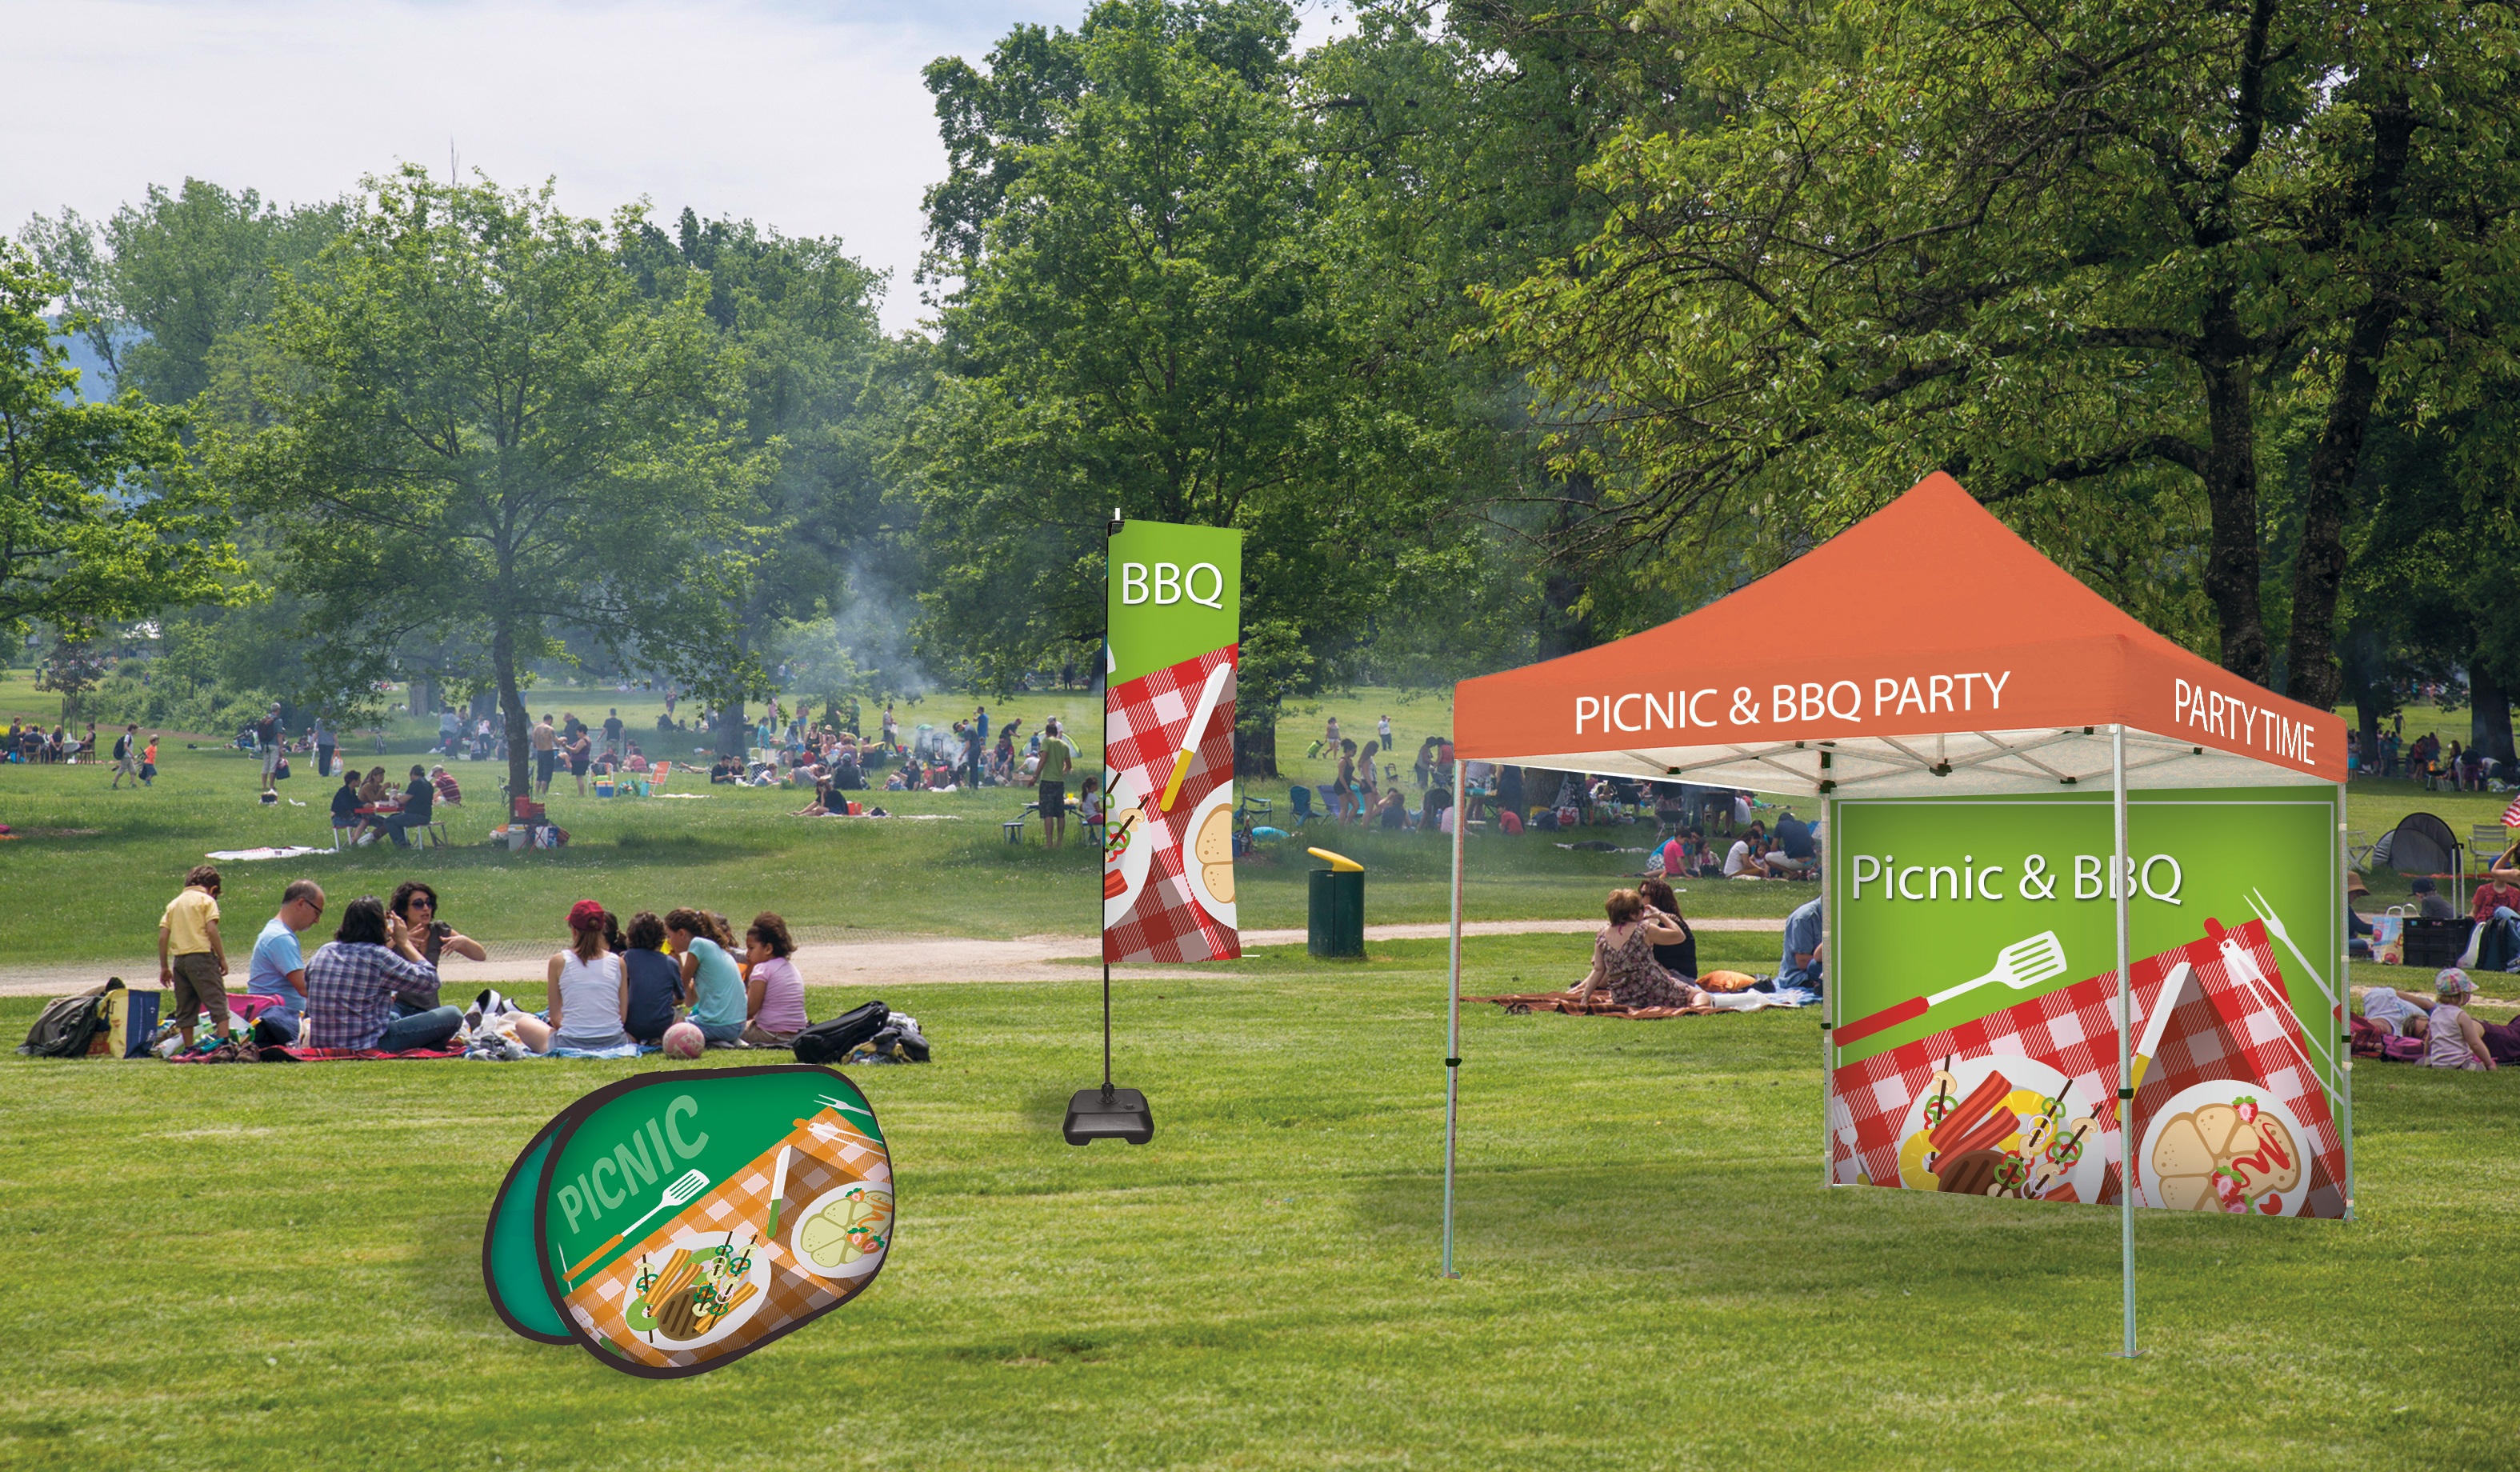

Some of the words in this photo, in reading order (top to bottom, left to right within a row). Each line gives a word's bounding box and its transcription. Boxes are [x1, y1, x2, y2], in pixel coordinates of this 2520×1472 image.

[1123, 562, 1222, 610] BBQ
[1577, 689, 1717, 734] PICNIC
[1730, 687, 1760, 725] &
[1774, 681, 1861, 723] BBQ
[1875, 671, 2010, 717] PARTY
[2176, 678, 2257, 746] PARTY
[2261, 709, 2314, 766] TIME
[1854, 854, 2003, 900] Picnic
[2019, 854, 2056, 900] &
[2075, 854, 2182, 906] BBQ
[557, 1094, 710, 1234] PICNIC
